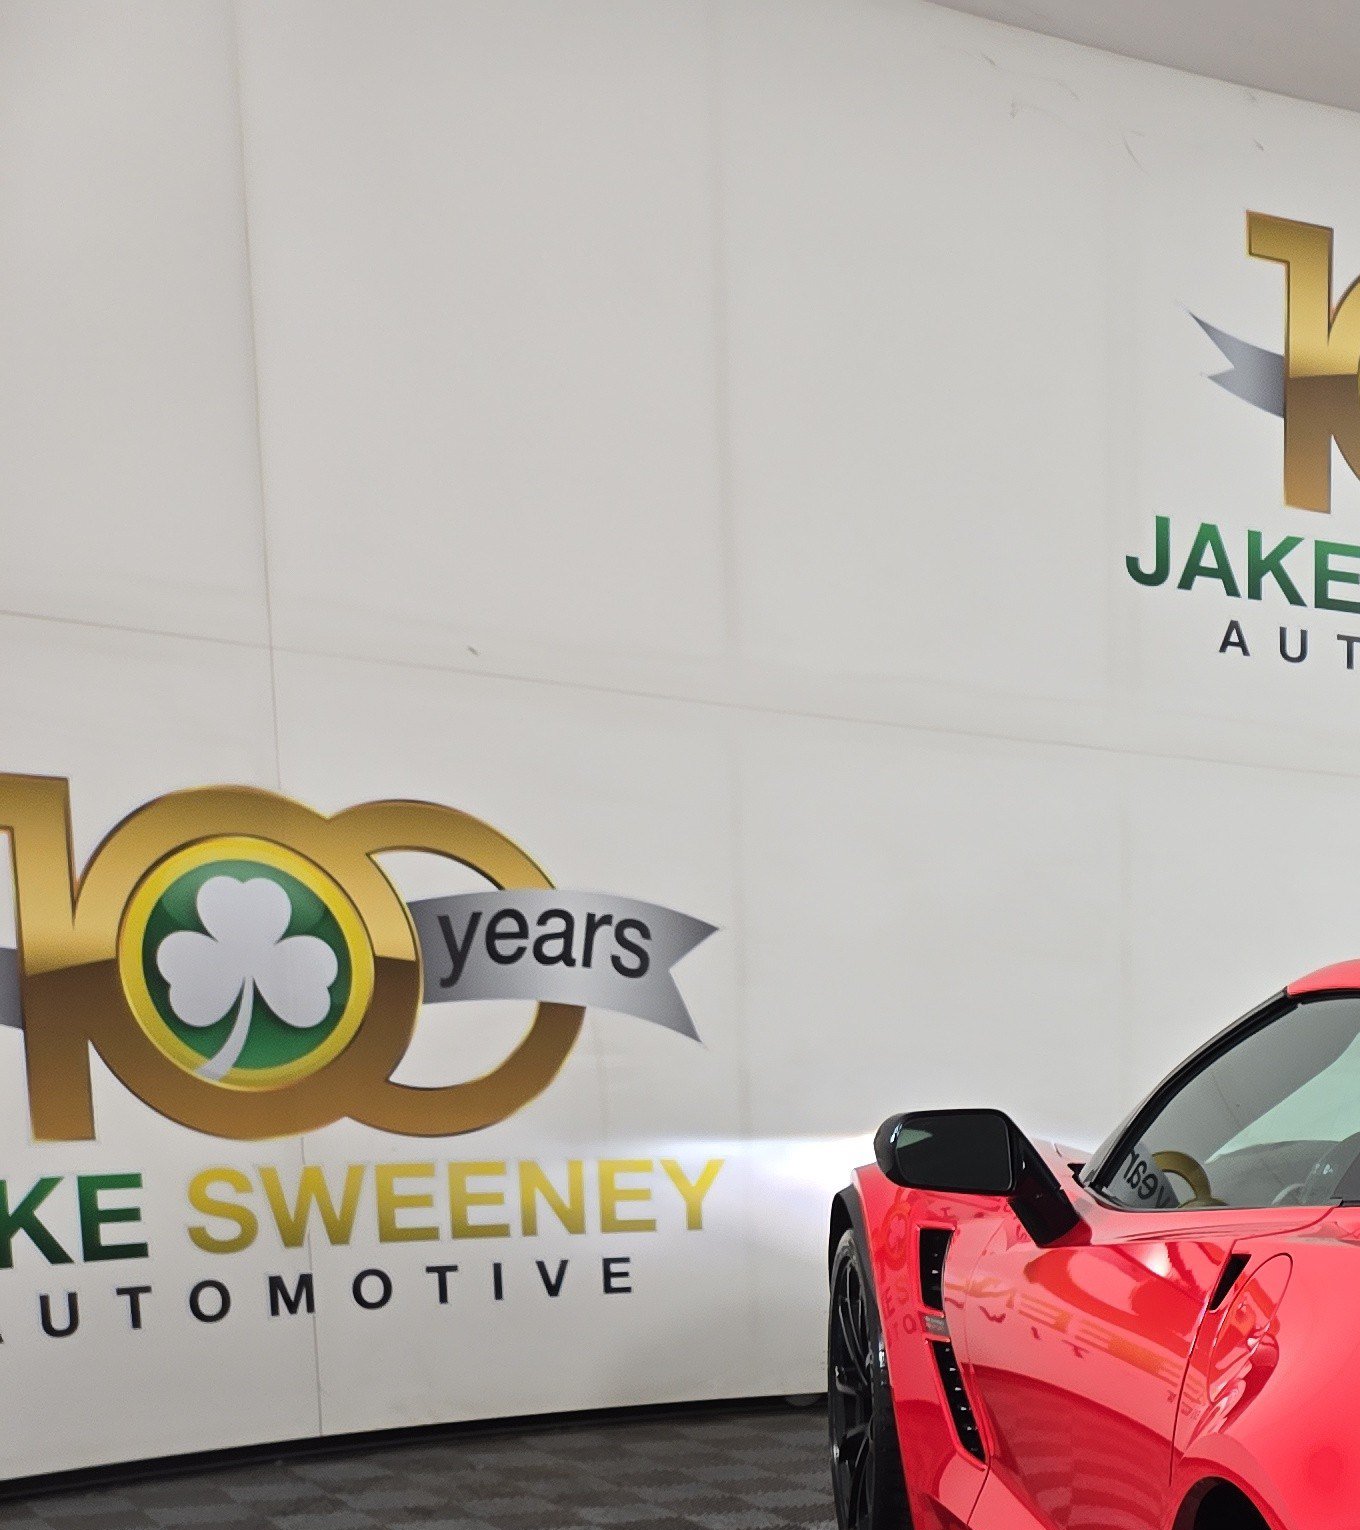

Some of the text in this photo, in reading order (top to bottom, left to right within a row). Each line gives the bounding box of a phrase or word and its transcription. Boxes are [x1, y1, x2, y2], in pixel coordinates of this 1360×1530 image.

[434, 907, 653, 990] years
[187, 1158, 726, 1255] SWEENEY
[0, 1257, 633, 1344] UTOMOTIVE
